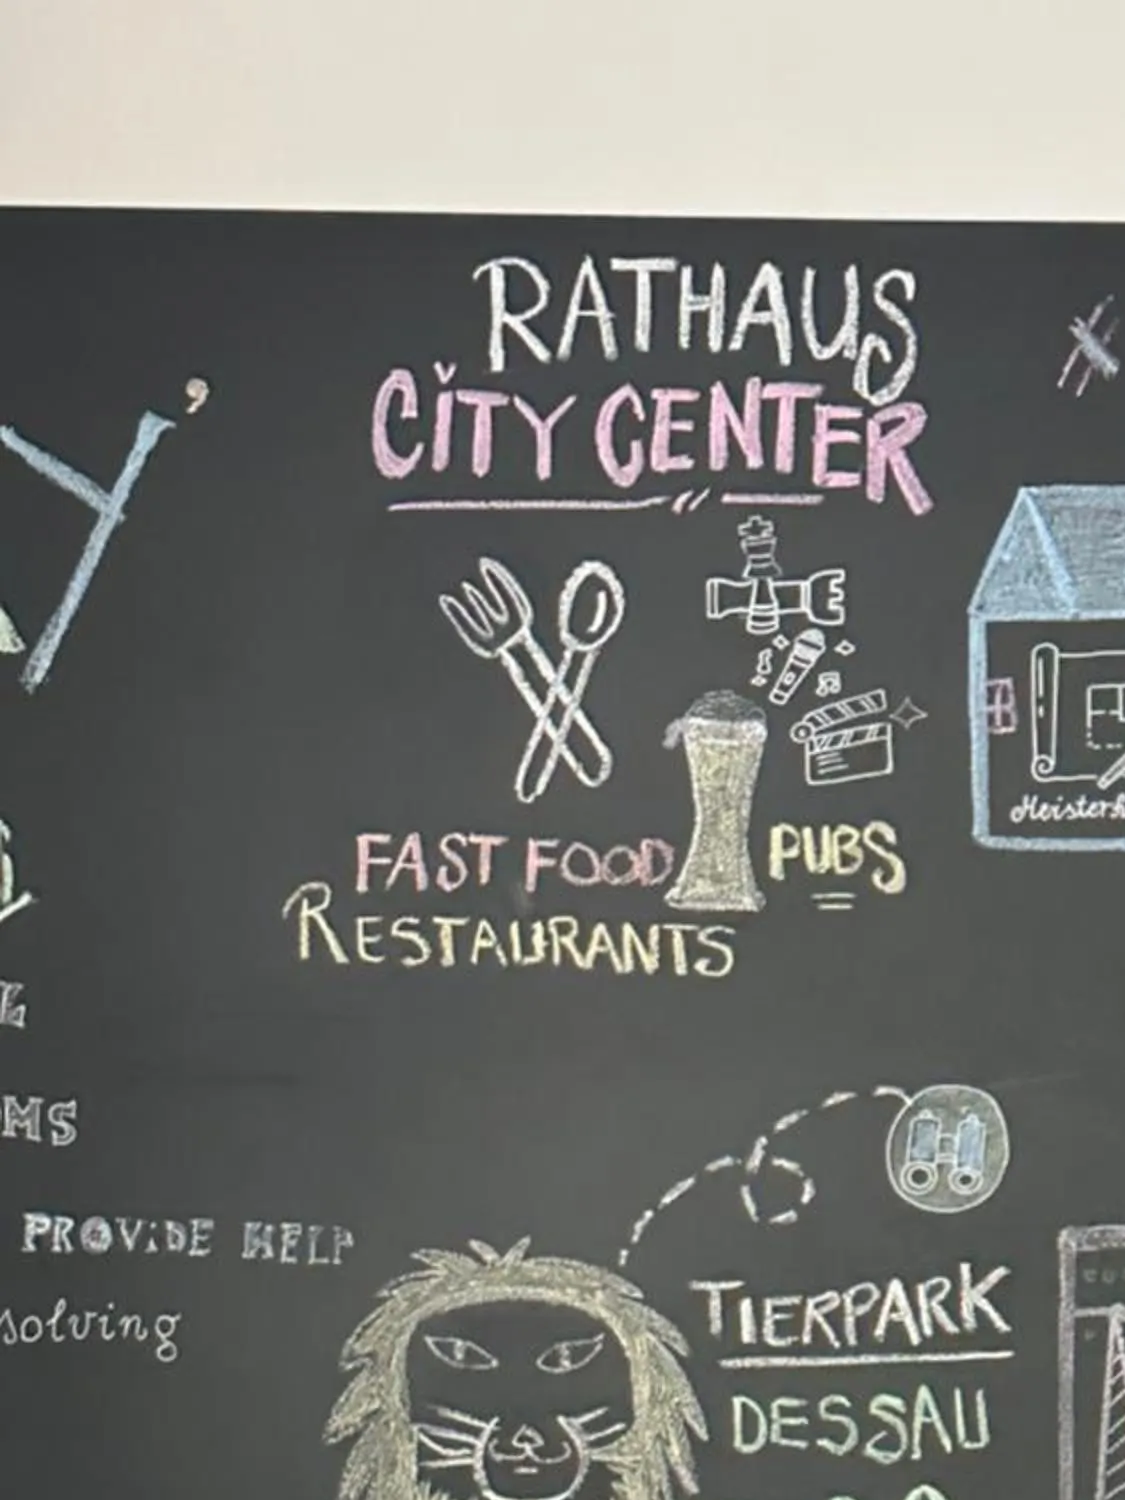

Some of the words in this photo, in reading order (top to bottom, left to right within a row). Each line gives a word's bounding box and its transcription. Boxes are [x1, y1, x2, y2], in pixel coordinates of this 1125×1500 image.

[473, 254, 918, 404] RATHAUS
[595, 376, 934, 516] CENTER
[355, 832, 508, 893] FAST
[525, 836, 675, 893] FOOD
[768, 821, 907, 894] PUBS
[283, 882, 737, 978] RESTAURANTS
[0, 1094, 79, 1147] MS
[240, 1219, 355, 1265] HELP
[688, 1262, 1012, 1348] TIERPARK
[731, 1384, 990, 1464] DESSAU
